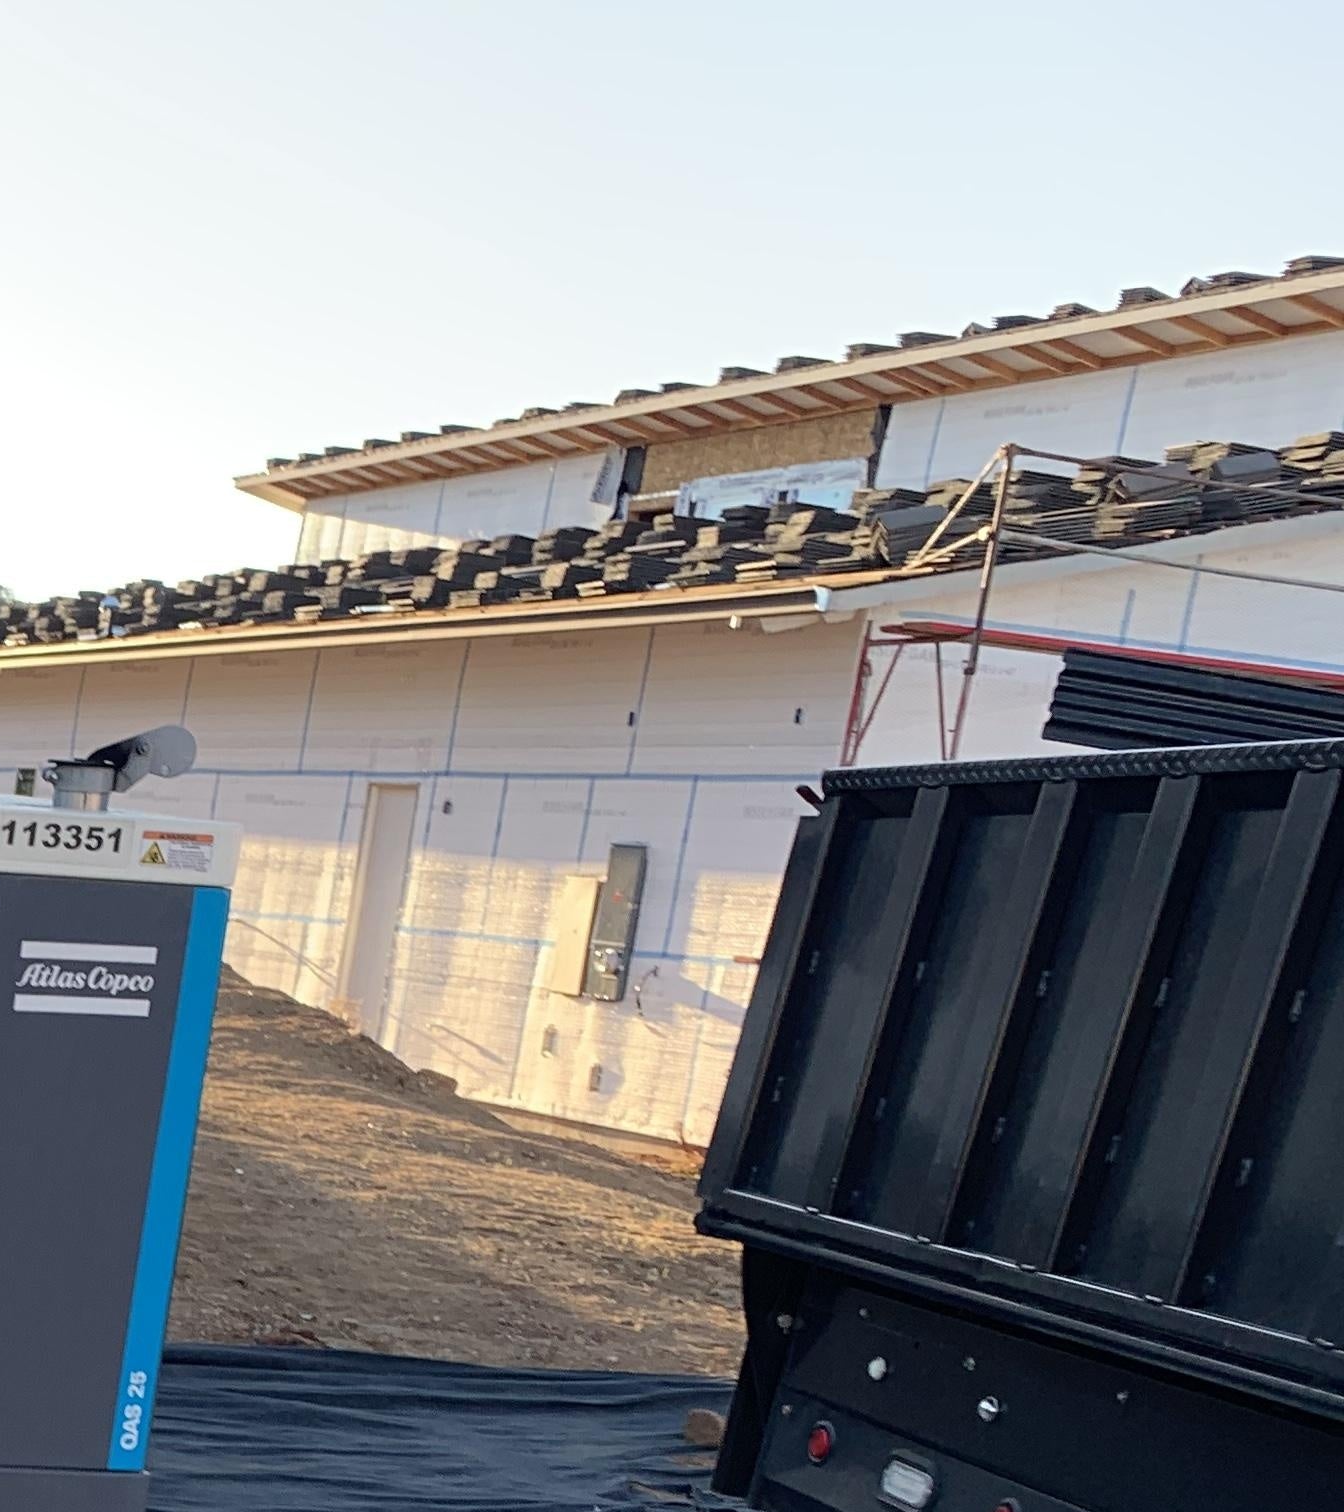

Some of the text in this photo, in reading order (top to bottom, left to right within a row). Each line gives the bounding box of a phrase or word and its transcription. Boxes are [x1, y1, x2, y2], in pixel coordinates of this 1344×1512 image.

[1, 820, 124, 853] 113351
[15, 963, 155, 996] Atlas Copco
[119, 1403, 143, 1451] QAS
